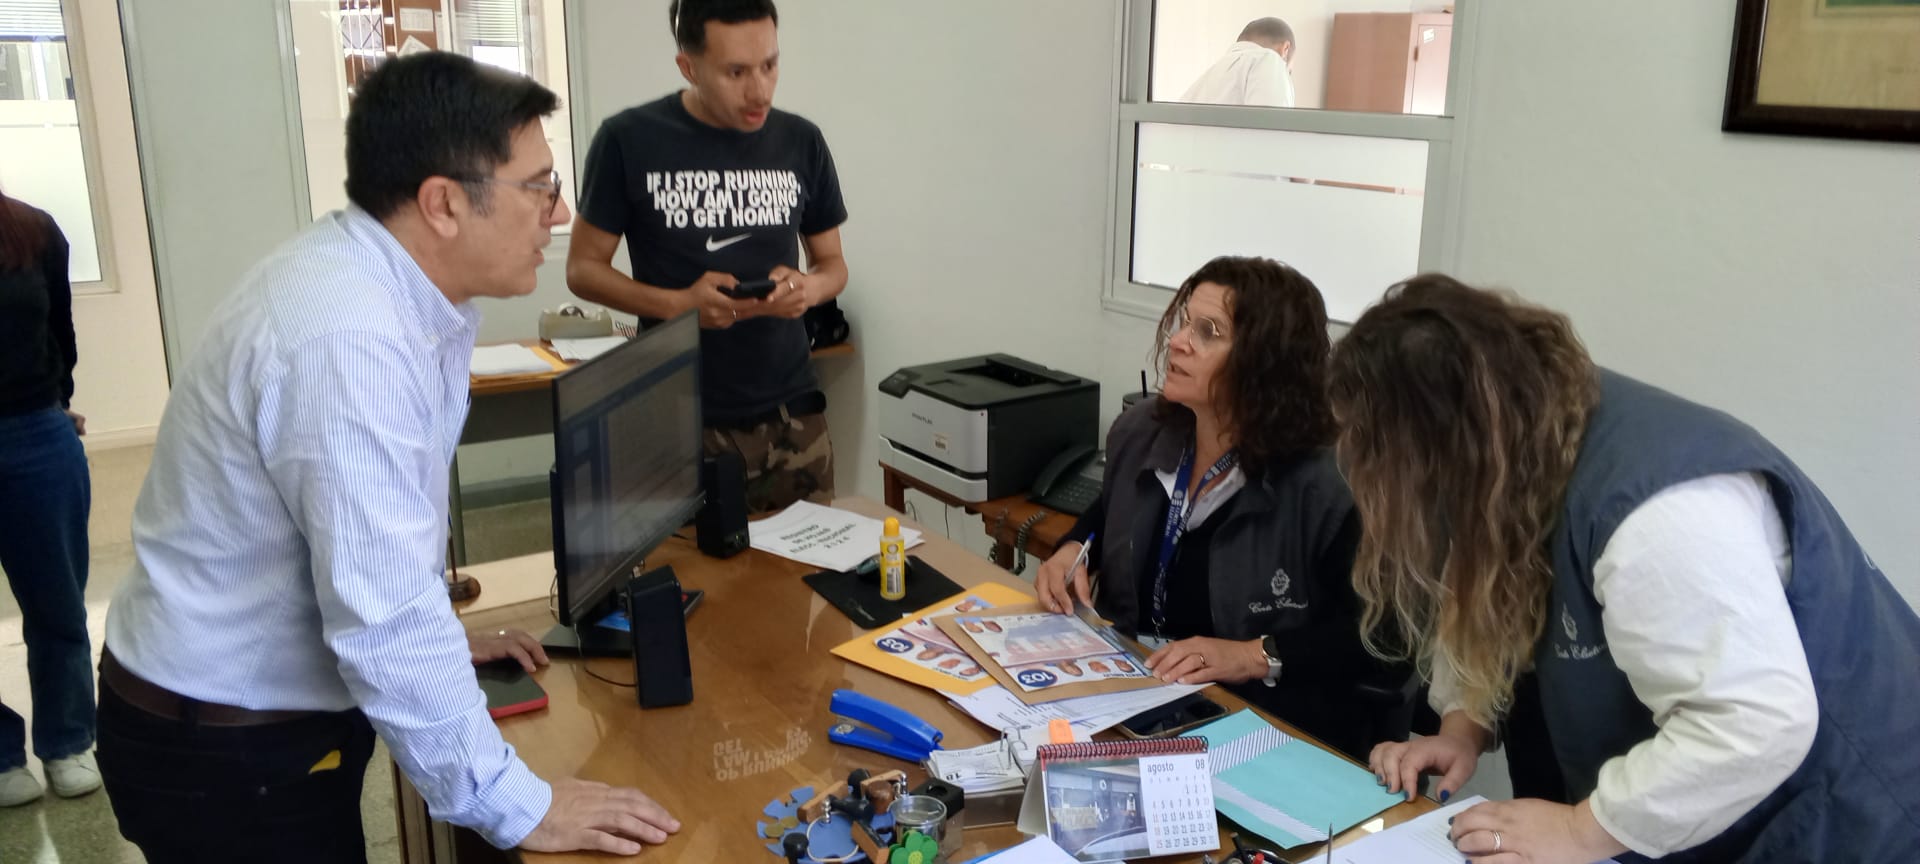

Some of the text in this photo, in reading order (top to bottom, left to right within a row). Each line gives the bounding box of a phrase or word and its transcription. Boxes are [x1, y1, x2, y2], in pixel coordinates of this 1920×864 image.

[646, 169, 802, 194] IF I STOP RUNNING,
[654, 188, 798, 210] HOW AM I GOING
[664, 206, 791, 228] TO GET HOME?
[881, 638, 910, 652] 103
[1021, 671, 1054, 685] 103
[1147, 760, 1174, 775] agosto
[1162, 812, 1168, 822] 12
[1179, 810, 1186, 821] 14
[1188, 810, 1194, 820] 15
[1198, 822, 1205, 832] 23
